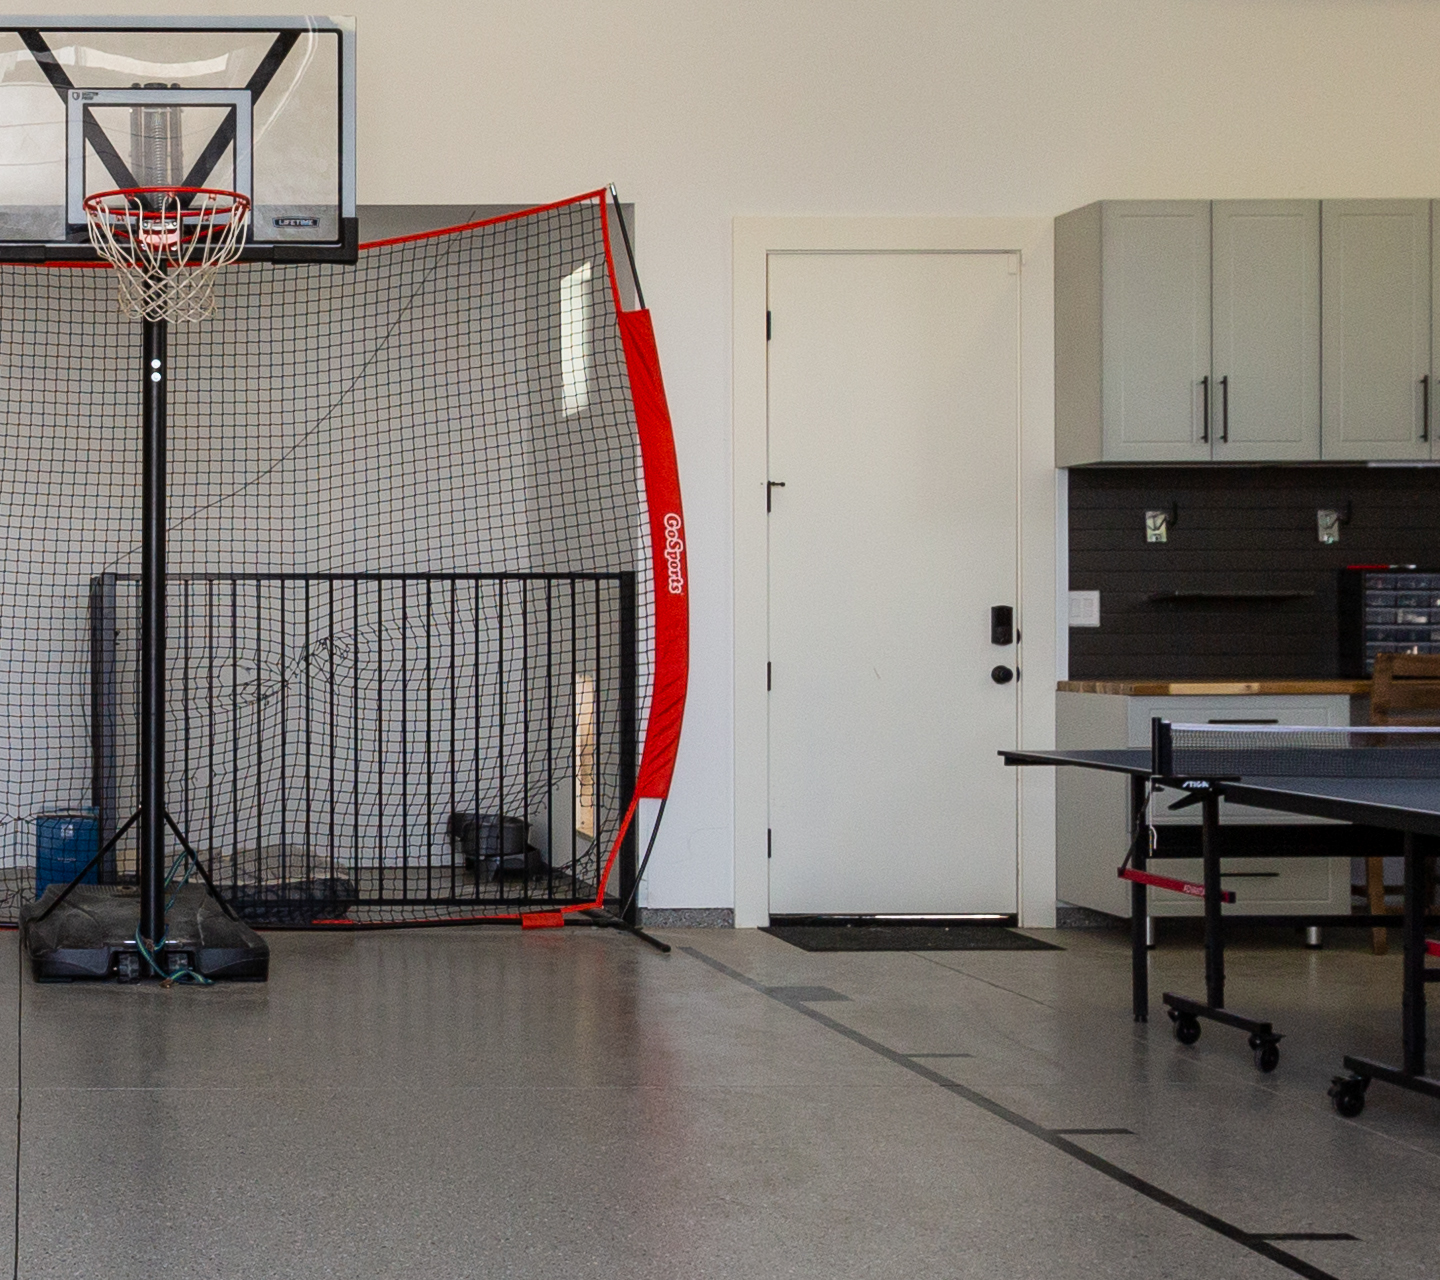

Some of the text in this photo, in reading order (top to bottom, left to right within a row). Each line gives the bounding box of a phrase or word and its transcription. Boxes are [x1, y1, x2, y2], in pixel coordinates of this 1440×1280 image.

[278, 219, 314, 227] LIFETIME
[663, 512, 684, 594] GoSports
[1182, 780, 1210, 788] STIGA
